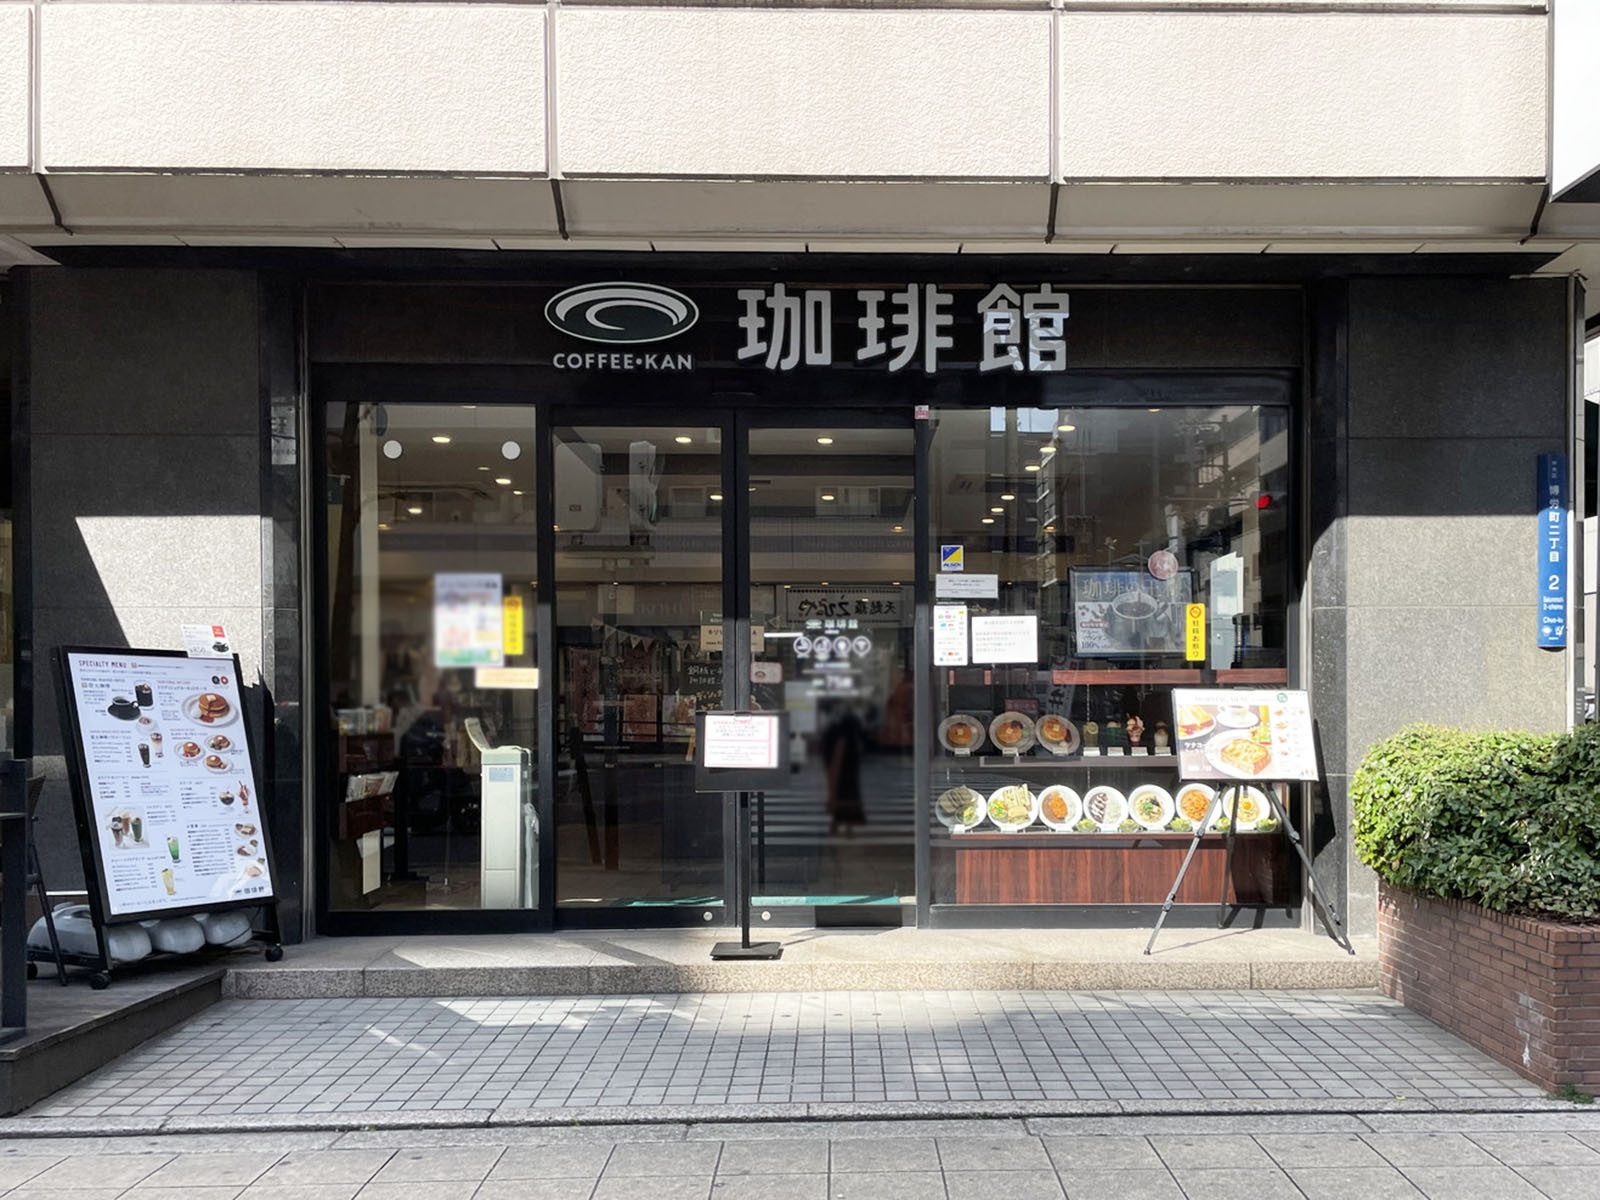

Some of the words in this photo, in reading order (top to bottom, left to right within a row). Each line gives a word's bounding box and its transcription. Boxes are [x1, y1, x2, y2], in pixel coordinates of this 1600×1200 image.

[737, 282, 1070, 373] 珈琲館
[1548, 575, 1560, 590] 2
[78, 659, 109, 668] SPECIALTY
[111, 661, 127, 669] MENU
